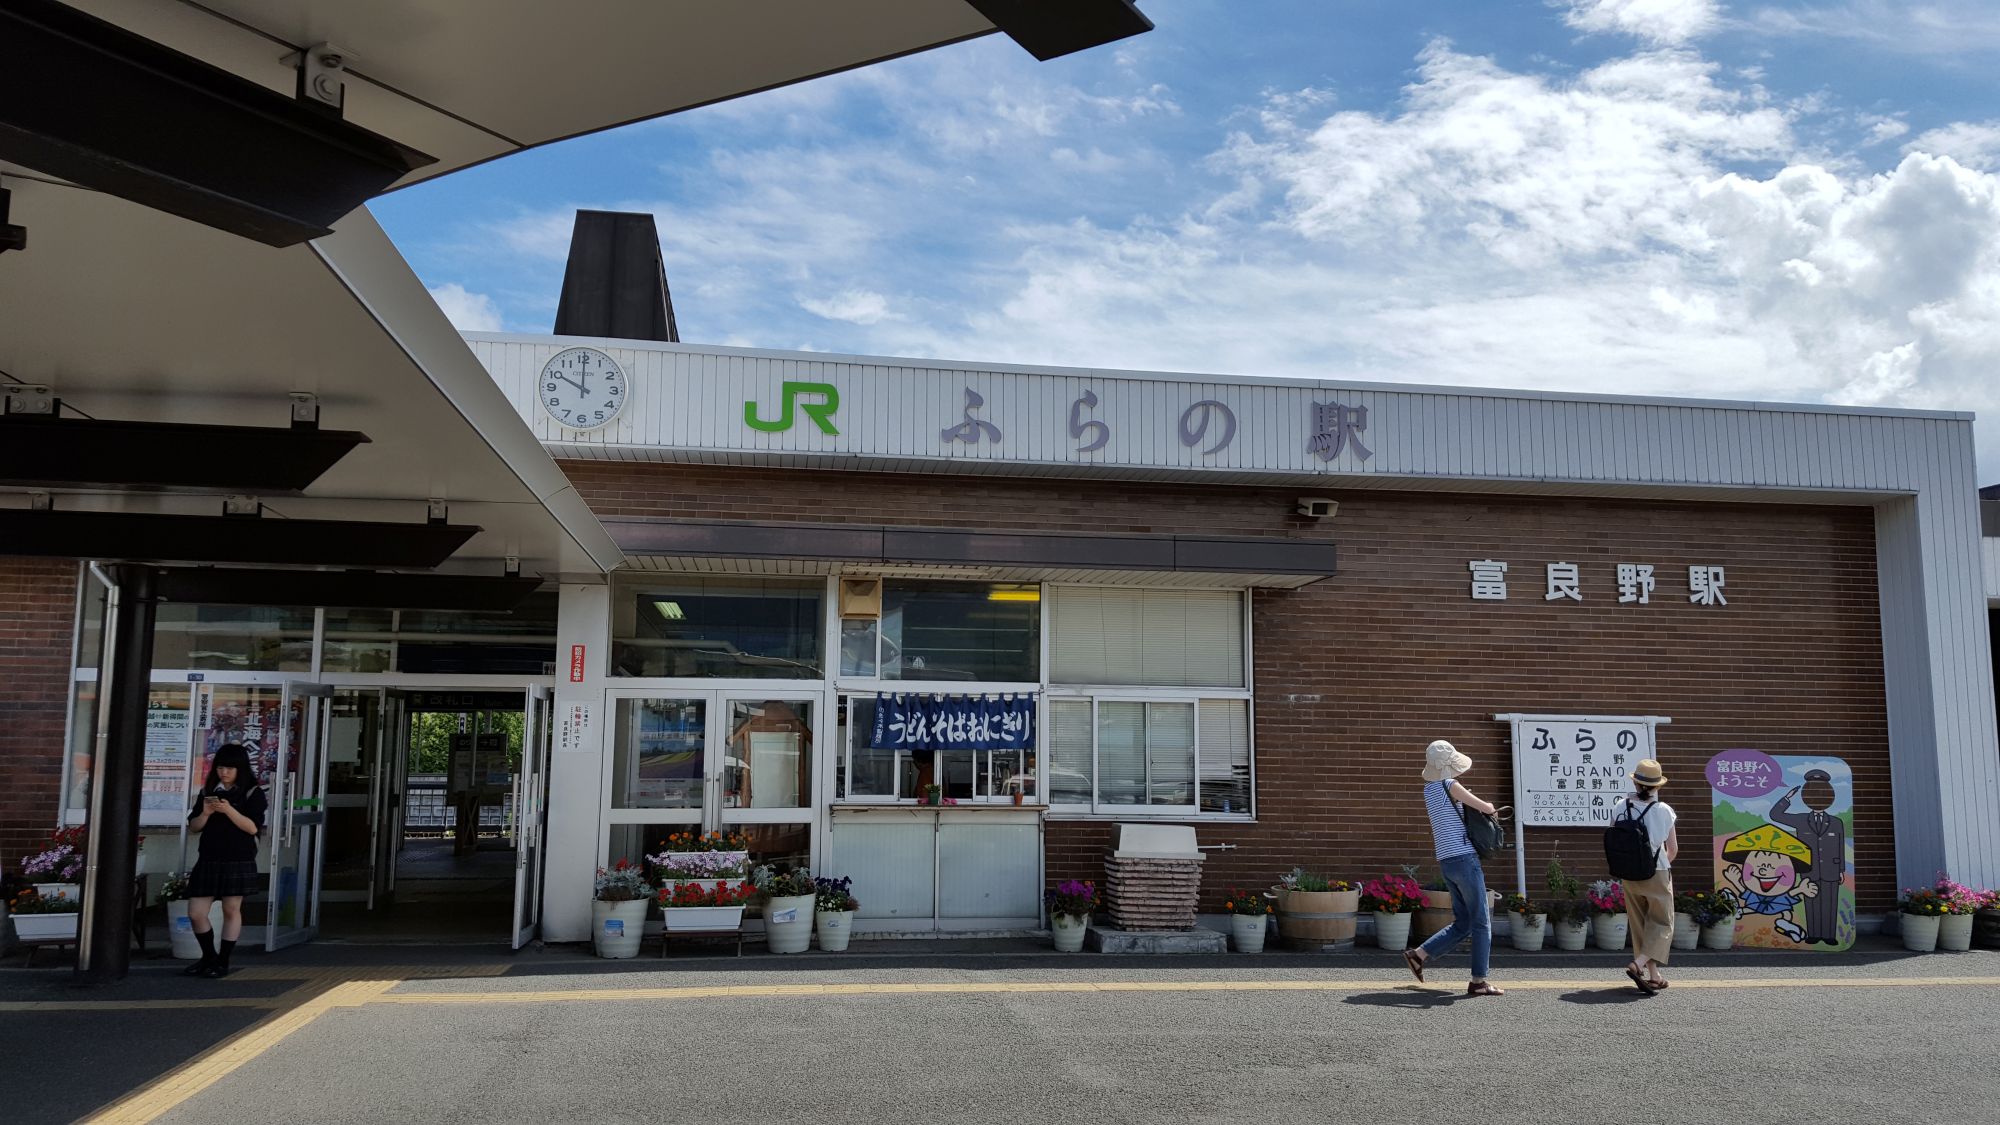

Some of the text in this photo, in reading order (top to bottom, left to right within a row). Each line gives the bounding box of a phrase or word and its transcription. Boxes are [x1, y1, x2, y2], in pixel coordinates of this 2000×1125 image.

[561, 360, 572, 368] 11
[578, 355, 590, 364] 12
[597, 360, 602, 368] 1
[549, 370, 563, 379] 10
[605, 371, 615, 380] 2
[546, 382, 557, 392] 9
[609, 386, 619, 395] 3
[549, 397, 560, 406] 8
[604, 400, 615, 409] 4
[745, 381, 840, 435] JR
[561, 409, 572, 418] 7
[576, 414, 587, 423] 6
[594, 410, 604, 420] 5
[941, 386, 1374, 462] ふらの駅
[1469, 559, 1728, 606] 富良野駅
[1531, 727, 1637, 752] ふらの
[1549, 753, 1625, 765] 富良野
[1550, 766, 1625, 778] FURANO
[1716, 760, 1772, 774] 富良野へ
[1716, 775, 1769, 788] ようこそ
[1592, 809, 1613, 821] NU
